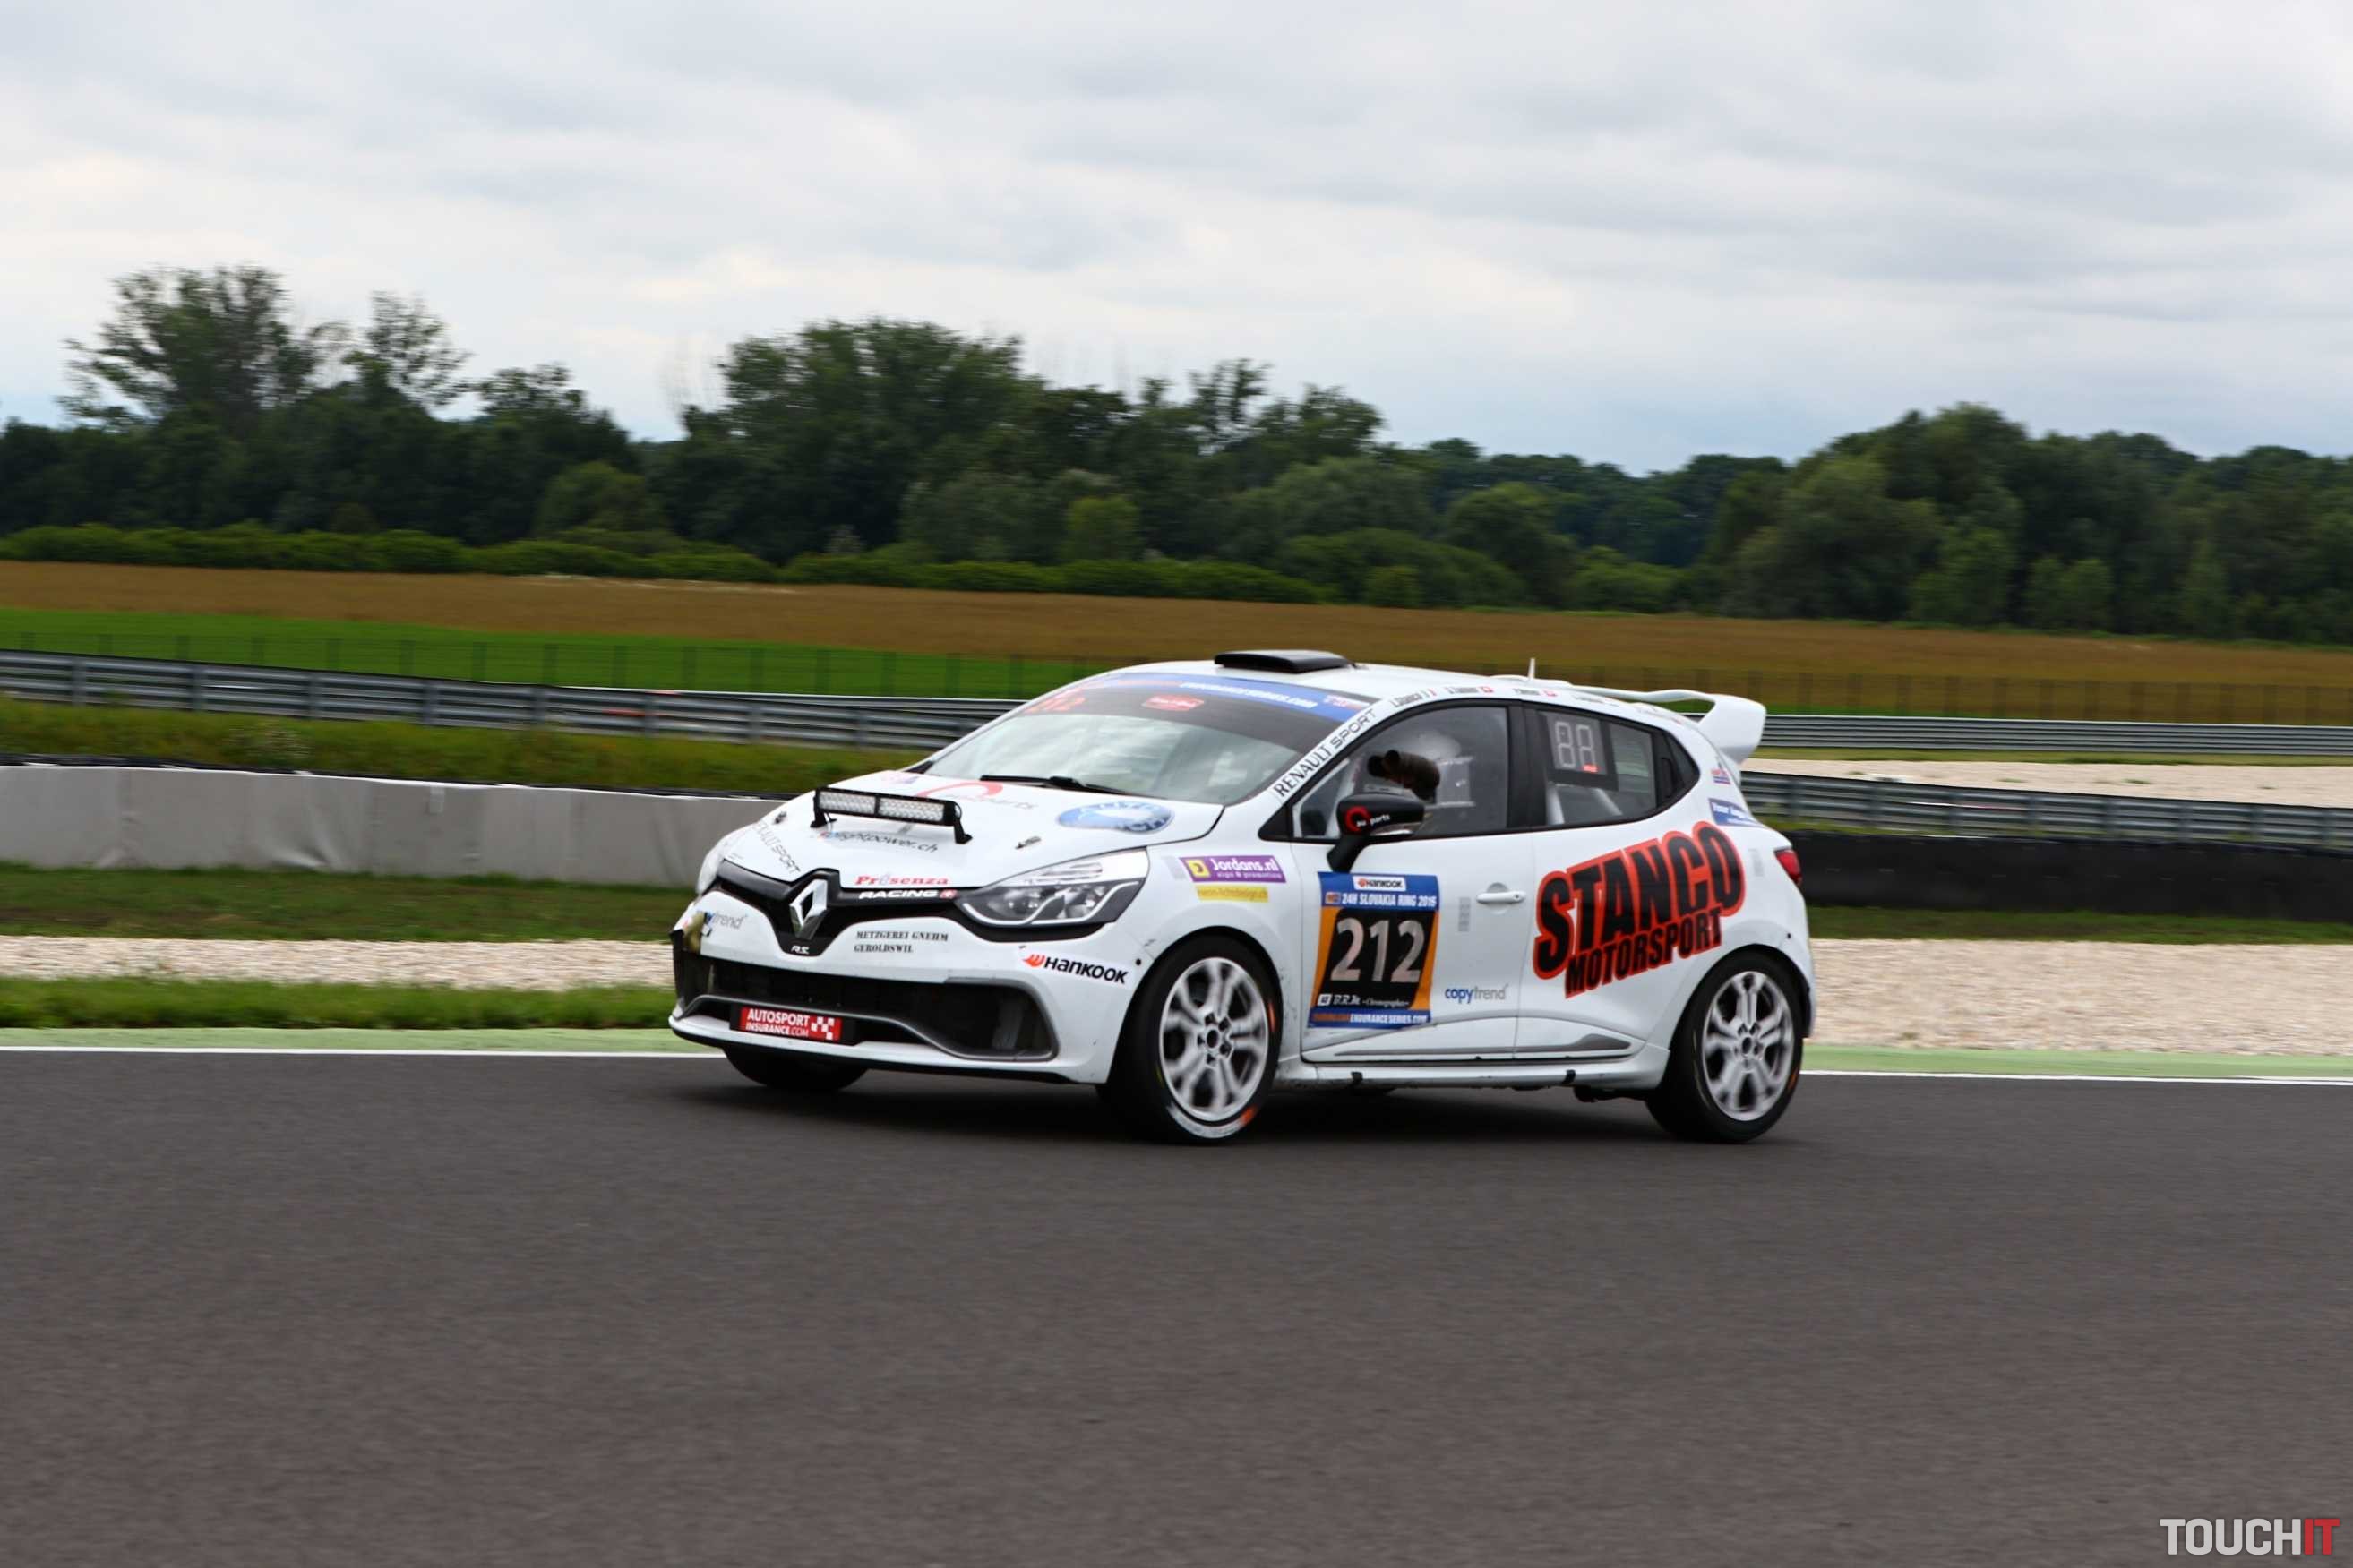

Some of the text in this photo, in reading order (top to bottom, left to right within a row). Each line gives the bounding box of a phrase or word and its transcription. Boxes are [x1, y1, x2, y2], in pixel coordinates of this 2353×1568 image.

[1274, 708, 1377, 797] RENAULT SPORT
[1210, 858, 1280, 871] Jordans.nl
[858, 889, 940, 900] RACING
[1342, 893, 1358, 904] 24H
[1359, 894, 1396, 906] SLOVAKIA
[1533, 821, 1745, 979] STANCO
[856, 931, 909, 939] METZGEREI
[854, 945, 914, 953] GEROLDSWIL
[1330, 918, 1425, 983] 212
[1565, 907, 1722, 998] MOTORSPORT
[1445, 985, 1507, 1004] copytrend
[747, 1008, 810, 1027] AUTOSPORT
[745, 1022, 810, 1038] INSURANCE.COM
